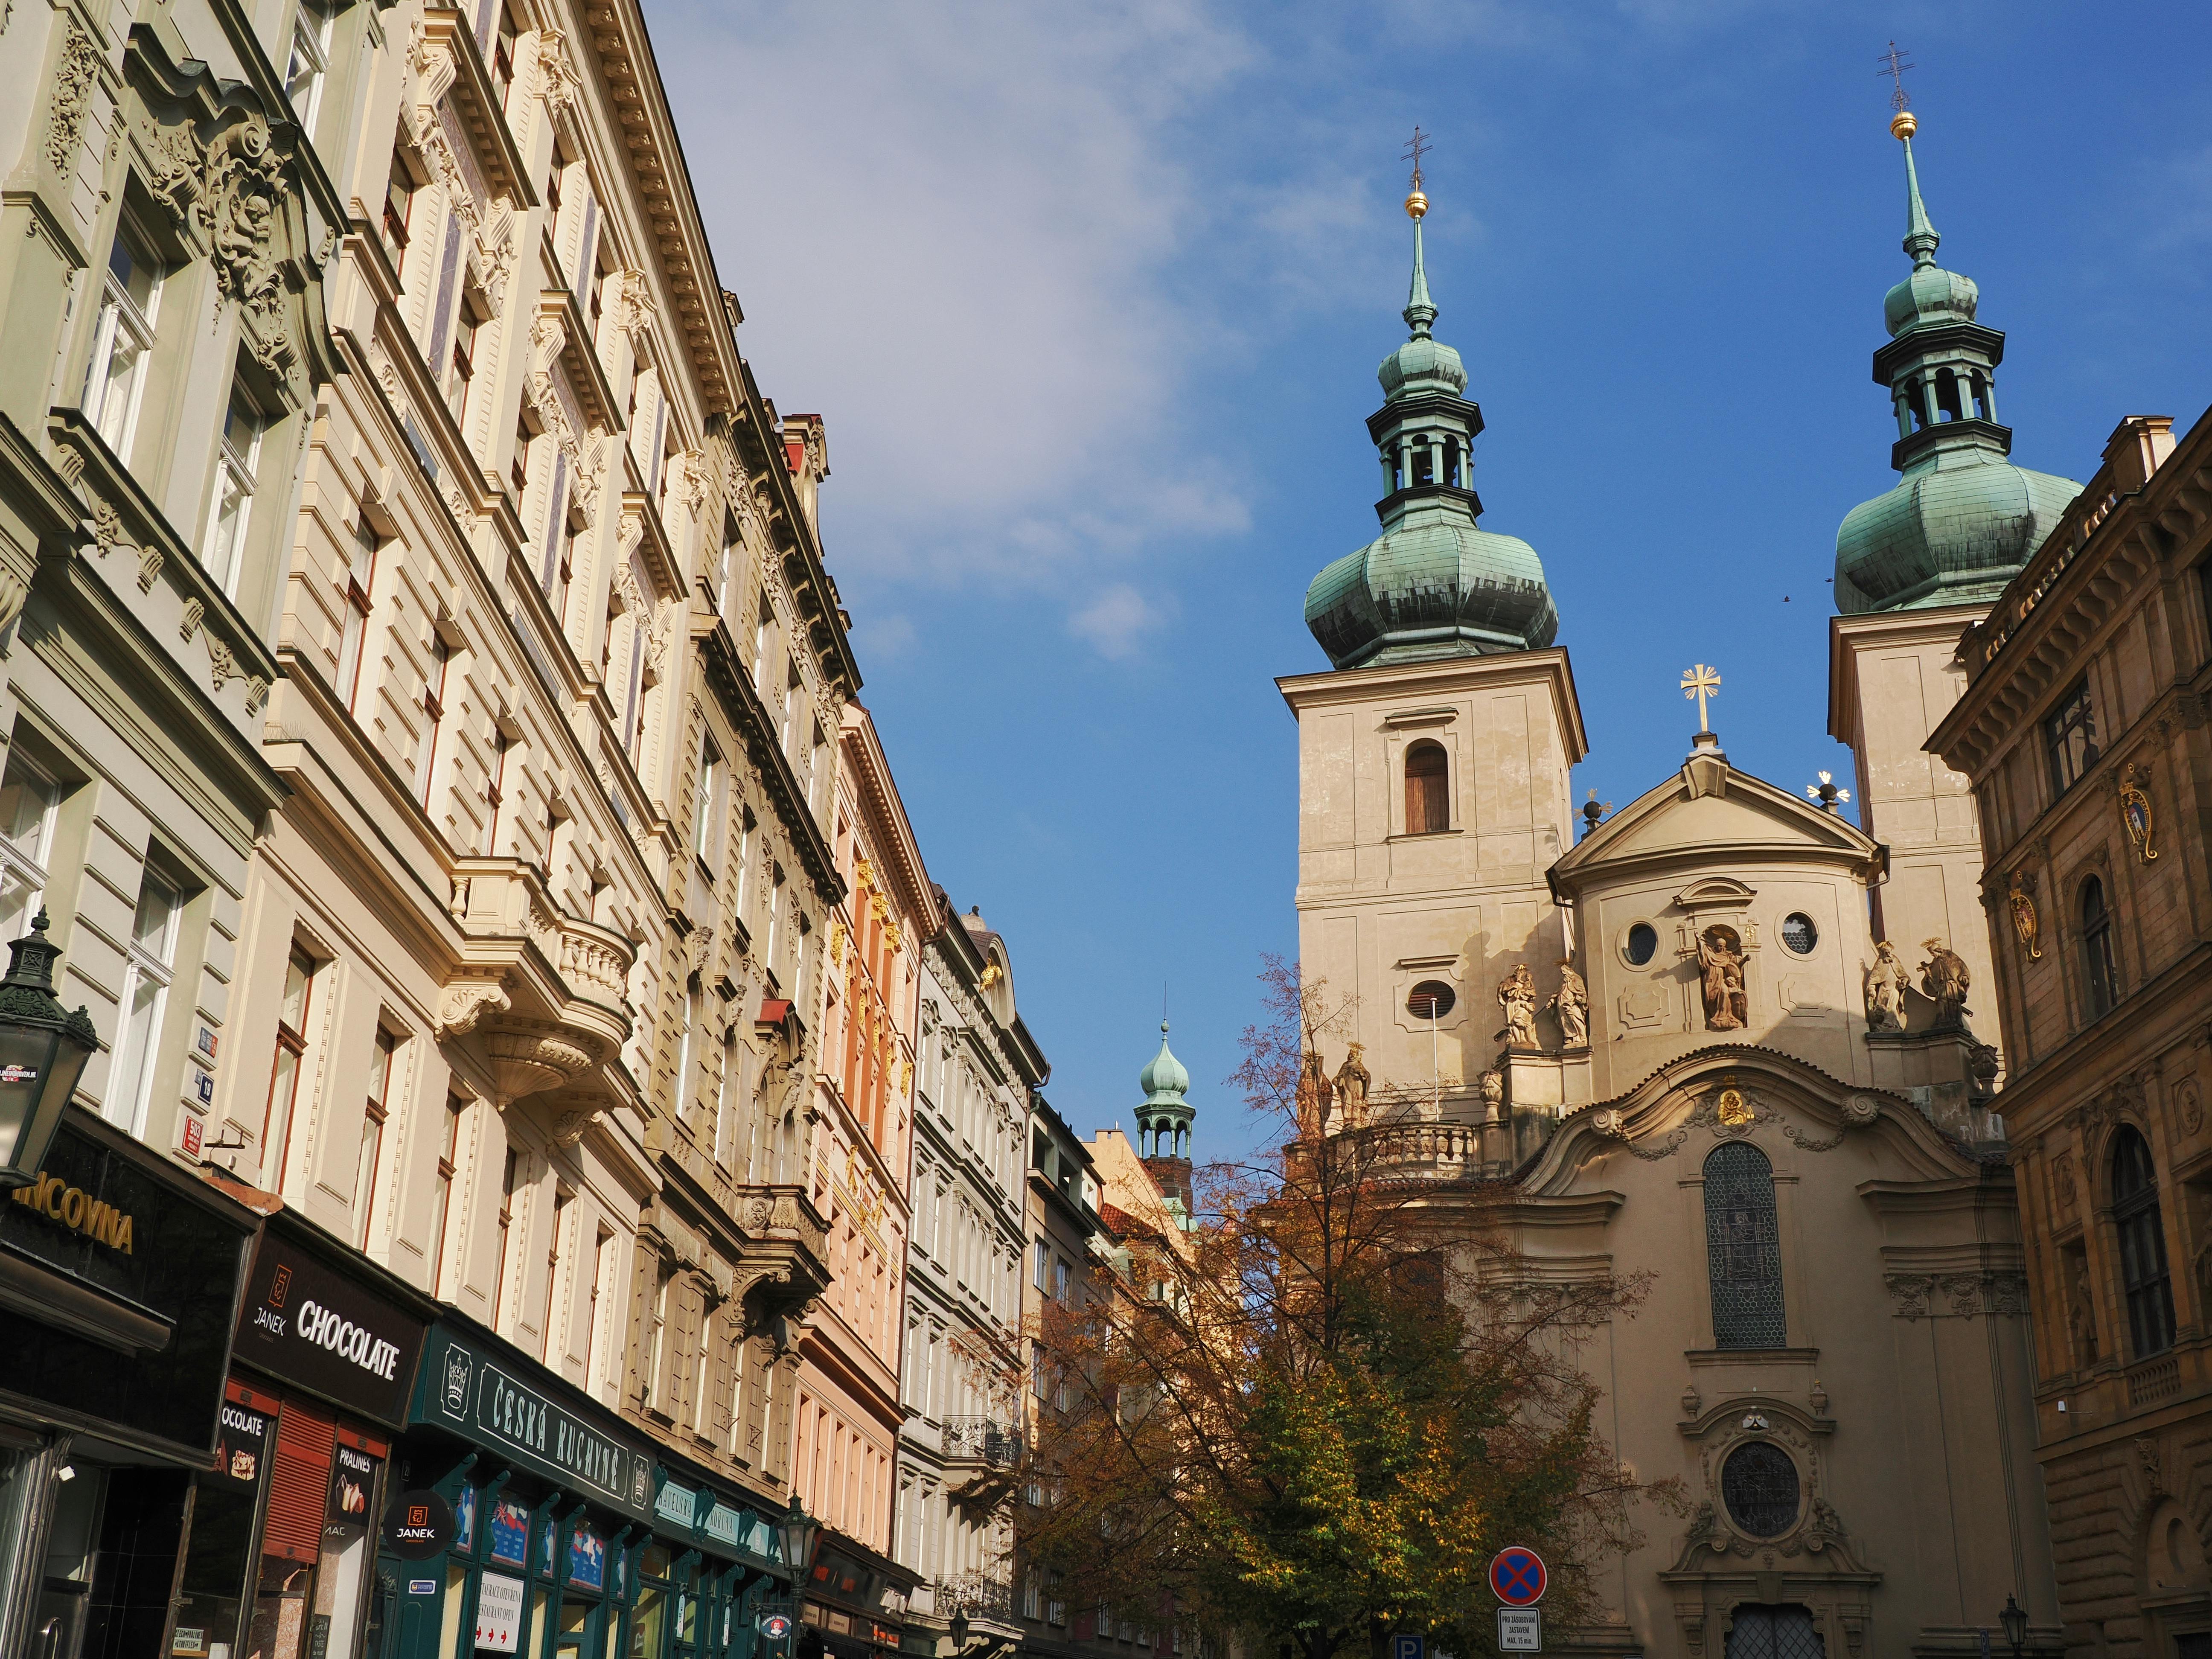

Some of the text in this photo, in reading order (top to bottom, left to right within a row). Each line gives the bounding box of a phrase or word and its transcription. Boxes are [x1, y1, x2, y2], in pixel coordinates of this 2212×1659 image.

[204, 1081, 211, 1097] 19
[190, 1120, 201, 1138] 503
[254, 1307, 287, 1336] JANEK
[297, 1300, 400, 1381] CHOCOLATE
[221, 1406, 263, 1436] OCOLATE
[494, 1376, 618, 1490] ČESKÁ KUCHYNĚ
[339, 1447, 370, 1473] PRALINES
[658, 1489, 733, 1534] HAVELSKÁ KORUNA
[396, 1528, 435, 1538] JANEK
[500, 1586, 521, 1603] OTEVŘENA
[503, 1608, 514, 1621] OPEN
[1511, 1615, 1536, 1623] ZÁSOBOVÁNÍ
[1509, 1626, 1529, 1634] ZASTAVENÍ
[1401, 1640, 1417, 1659] P
[1981, 1634, 1986, 1652] P
